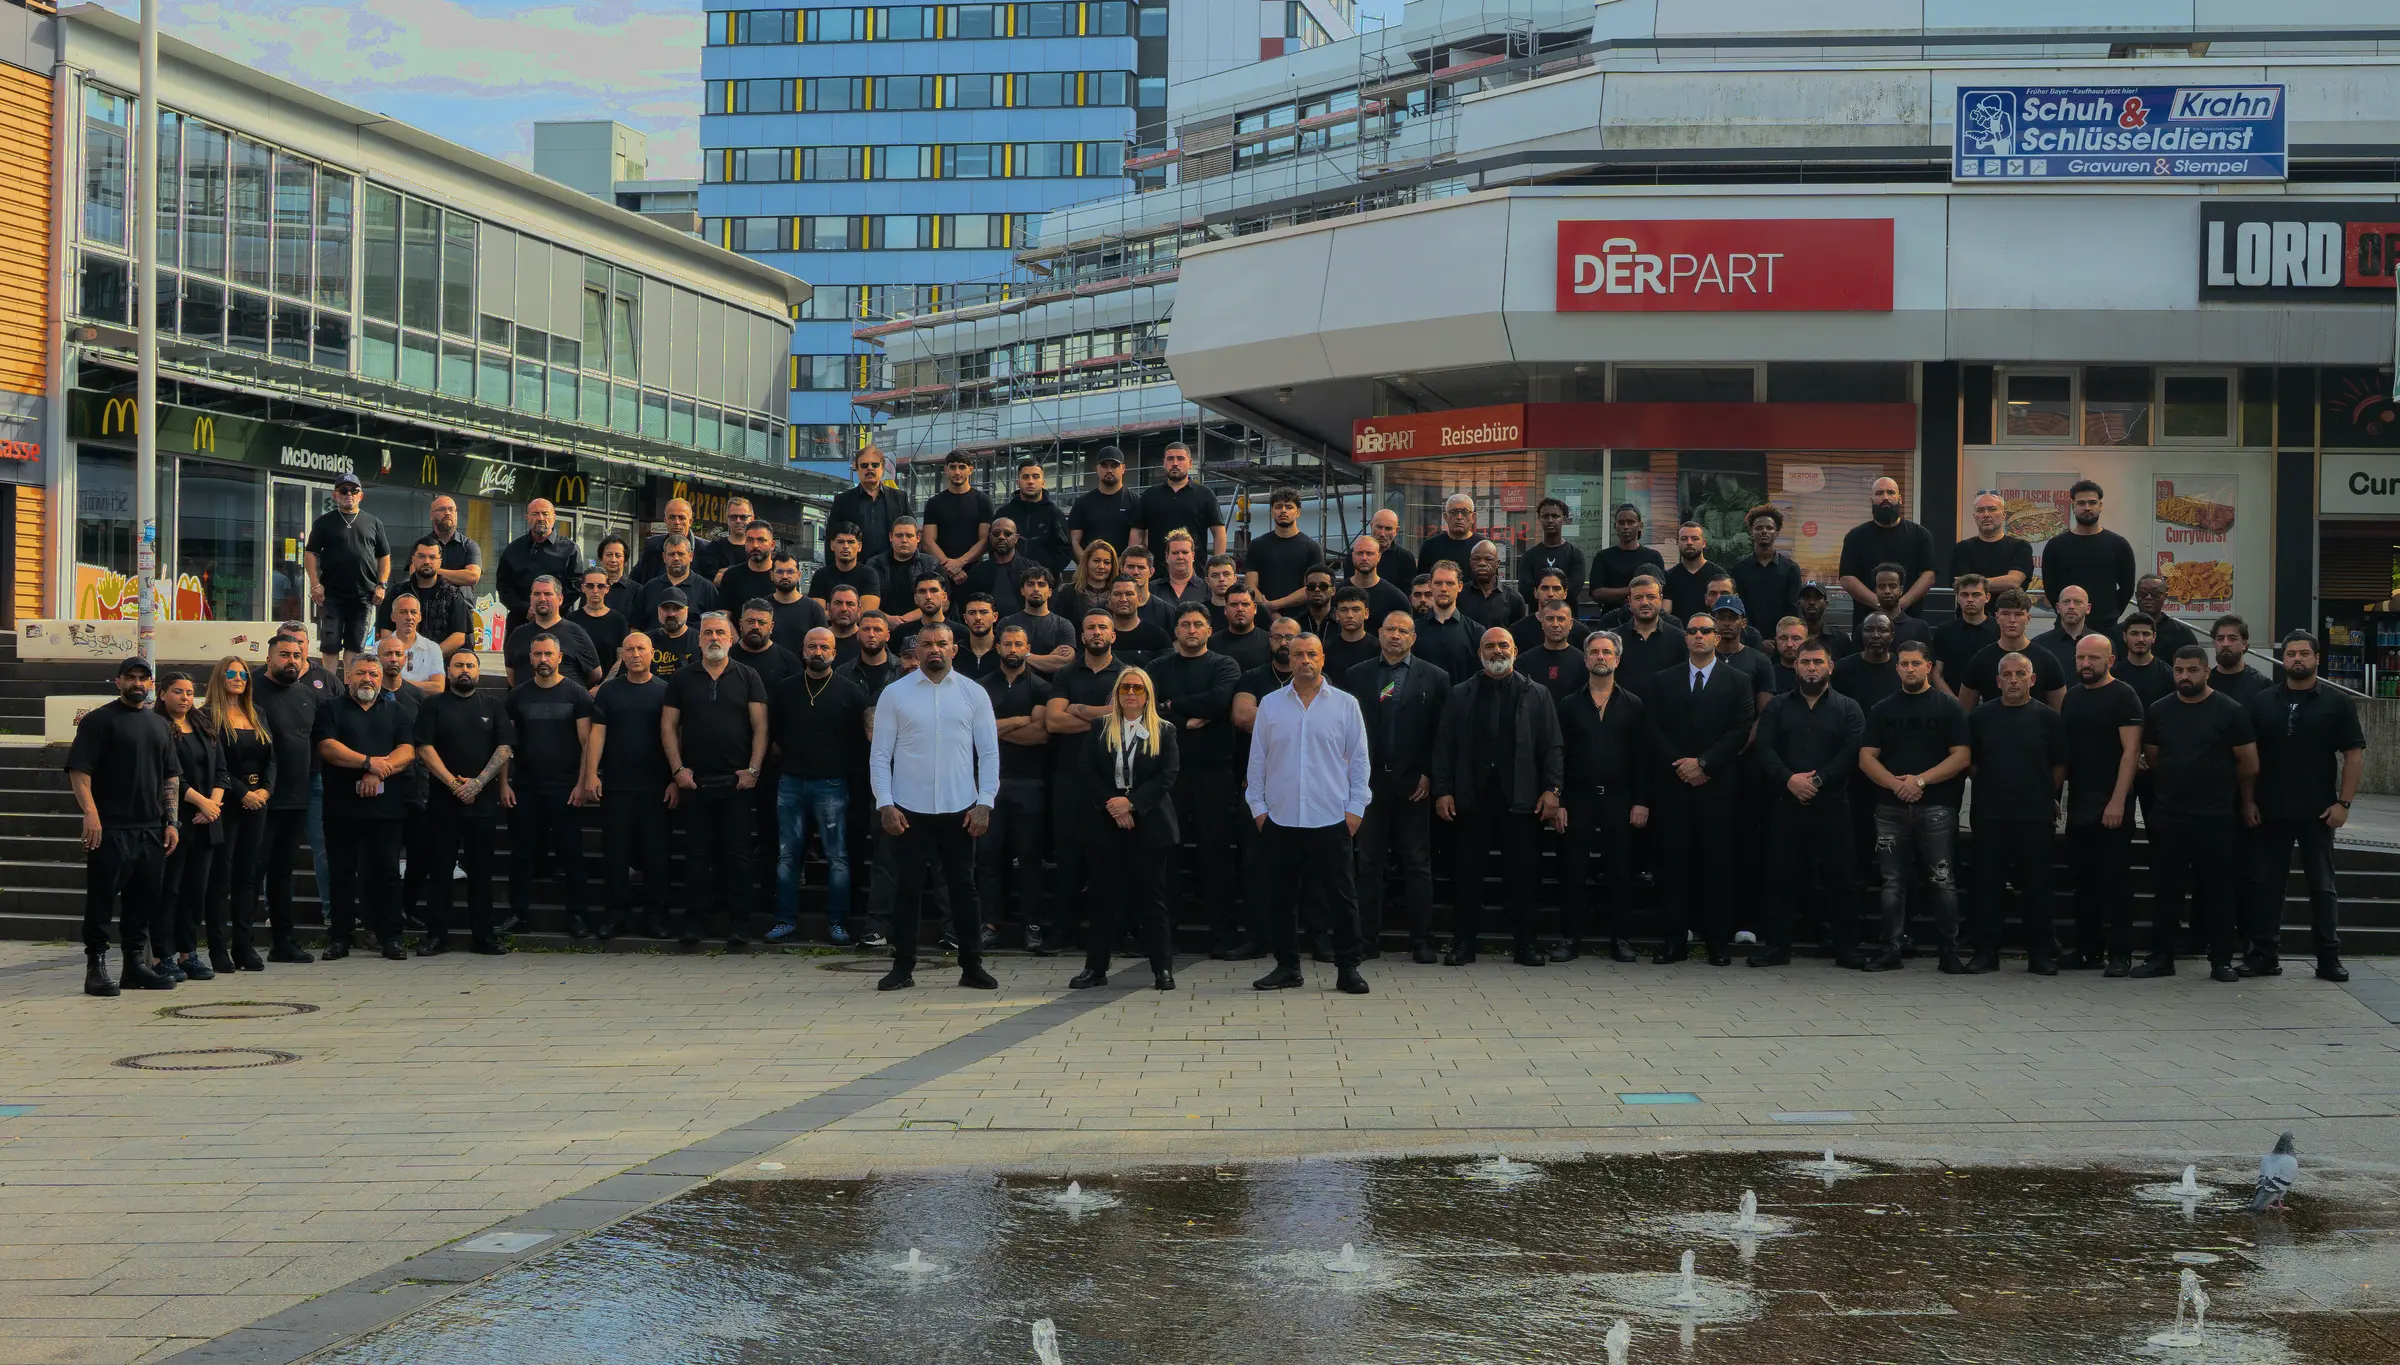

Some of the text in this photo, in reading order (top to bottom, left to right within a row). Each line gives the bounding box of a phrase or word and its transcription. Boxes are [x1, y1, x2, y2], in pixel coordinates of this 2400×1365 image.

[2105, 88, 2120, 96] jetzt
[2179, 92, 2271, 117] Krahn
[2022, 96, 2150, 129] Schuh &
[2022, 127, 2253, 151] Schlüsseldienst
[2068, 158, 2248, 175] Gravuren & Stempel
[2207, 221, 2342, 287] LORD
[1574, 252, 1784, 294] DERPART
[0, 439, 41, 462] asse
[1356, 422, 1518, 453] DERPART Reisebüro
[281, 446, 354, 474] McDonald's
[479, 464, 517, 494] McCafé
[2348, 472, 2400, 495] Cur
